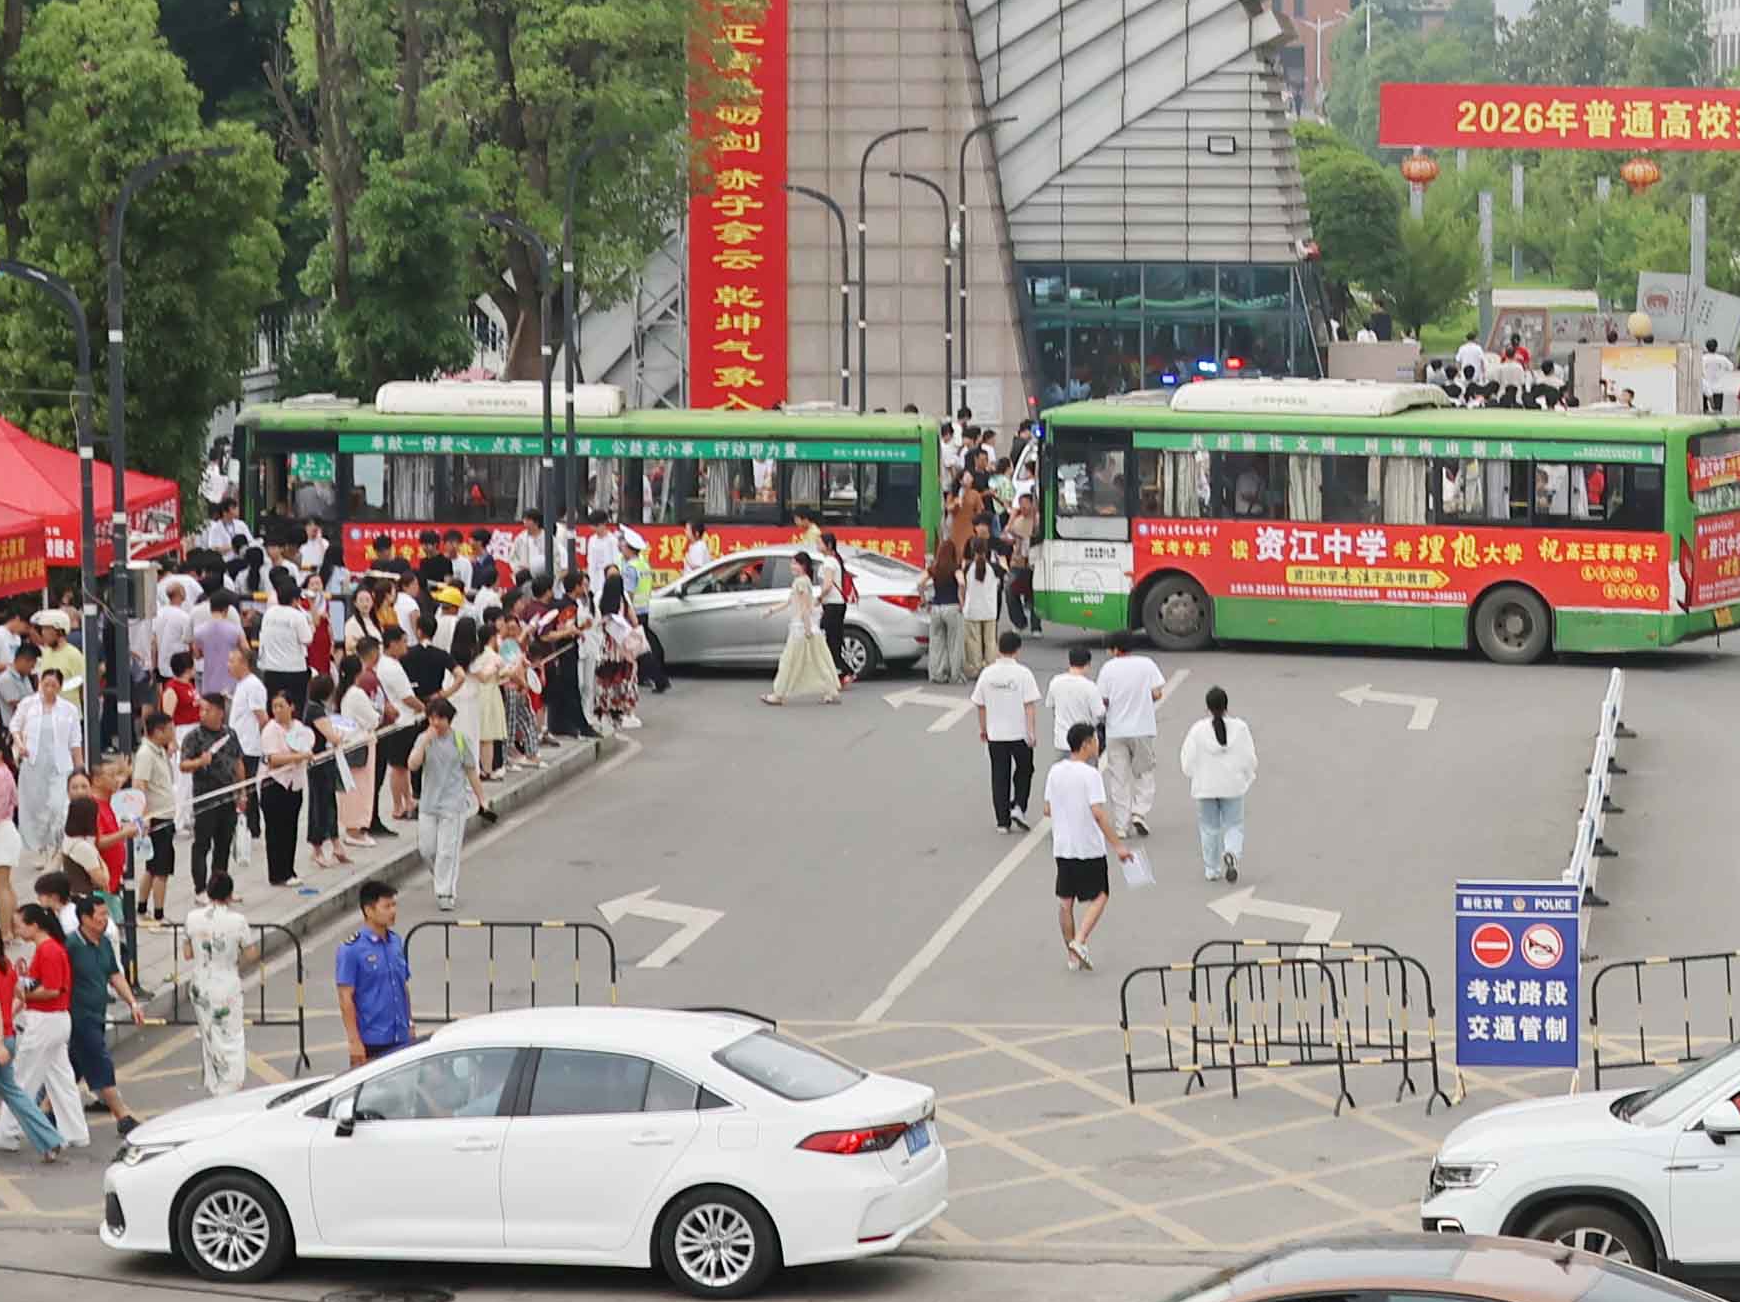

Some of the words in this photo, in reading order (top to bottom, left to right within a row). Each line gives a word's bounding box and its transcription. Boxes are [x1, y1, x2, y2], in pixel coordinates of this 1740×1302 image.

[1151, 539, 1212, 557] 高考专车
[1256, 526, 1387, 564] 资江中学
[1393, 541, 1412, 562] 考
[1418, 530, 1479, 568] 理想
[1483, 543, 1523, 564] 大学
[1534, 897, 1573, 911] POLICE
[1467, 978, 1569, 1007] 考试路段
[1467, 1014, 1569, 1043] 交通管制
